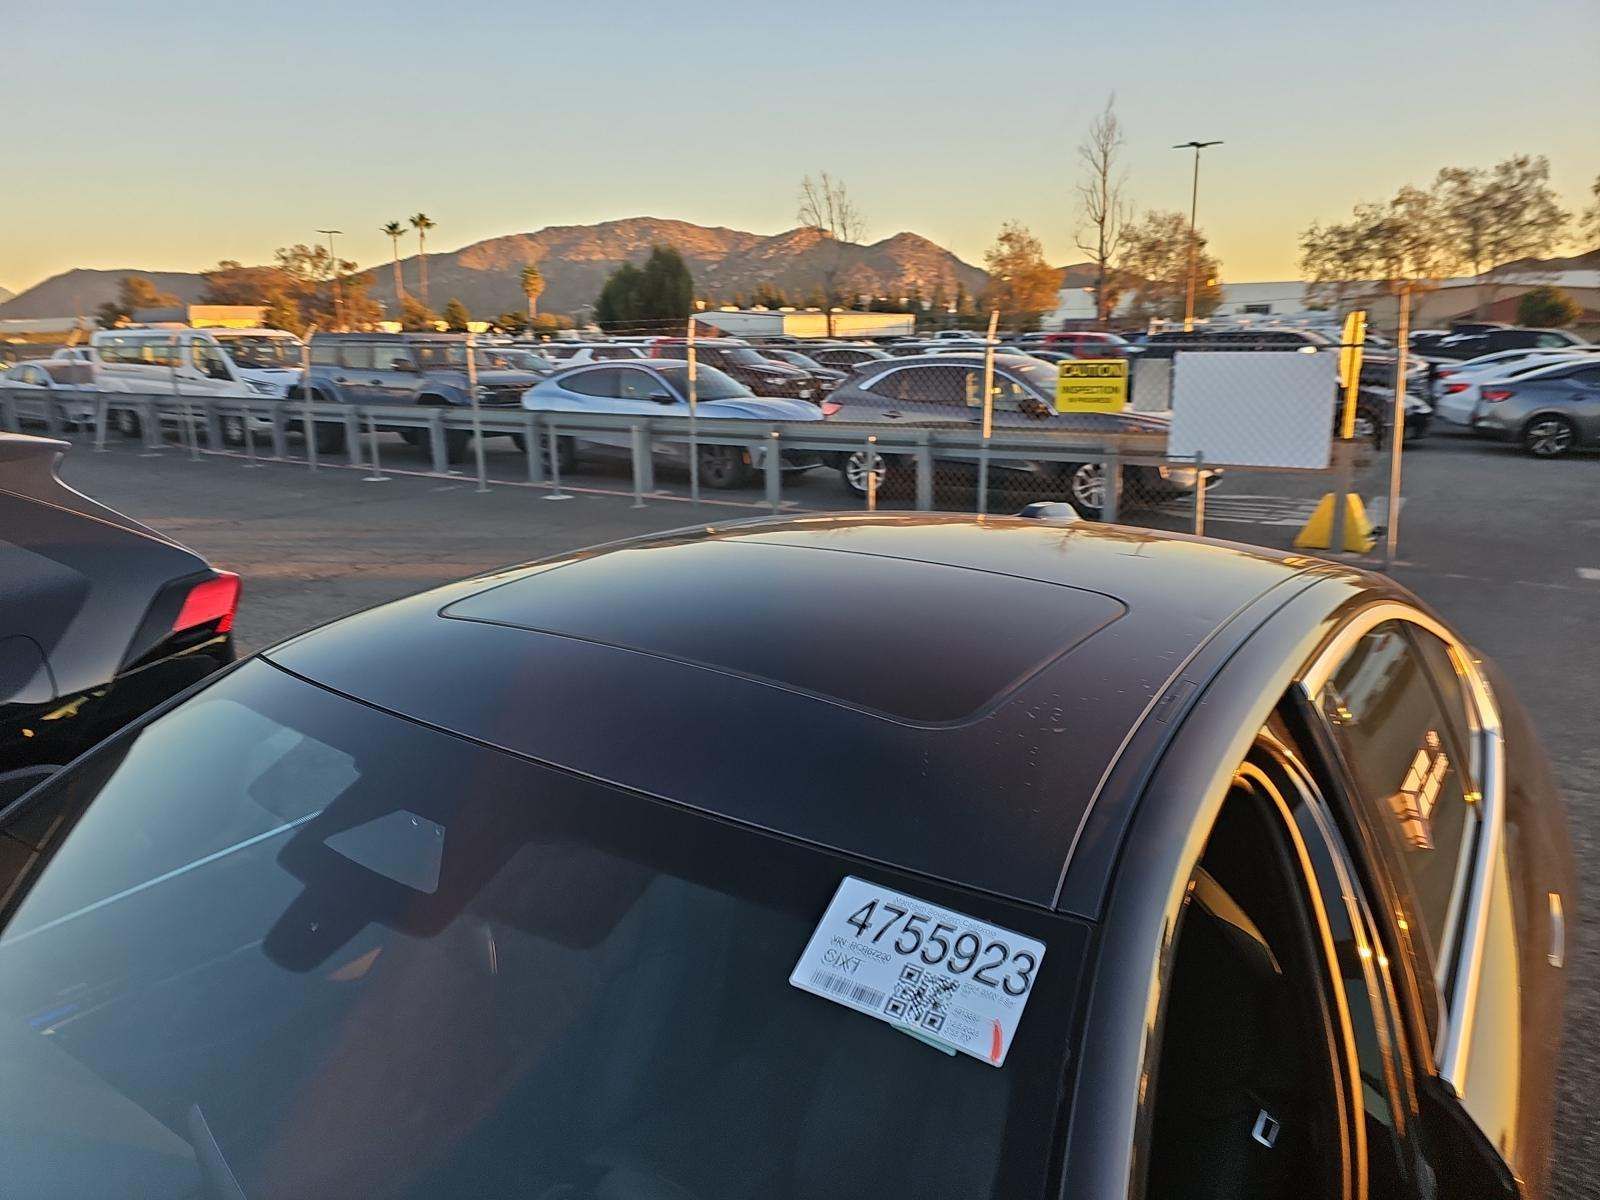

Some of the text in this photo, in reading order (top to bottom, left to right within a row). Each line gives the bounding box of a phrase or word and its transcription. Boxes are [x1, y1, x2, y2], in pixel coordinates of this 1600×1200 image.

[1063, 364, 1121, 377] CAUTION
[846, 899, 1037, 995] 4755923
[824, 949, 863, 972] SIXT
